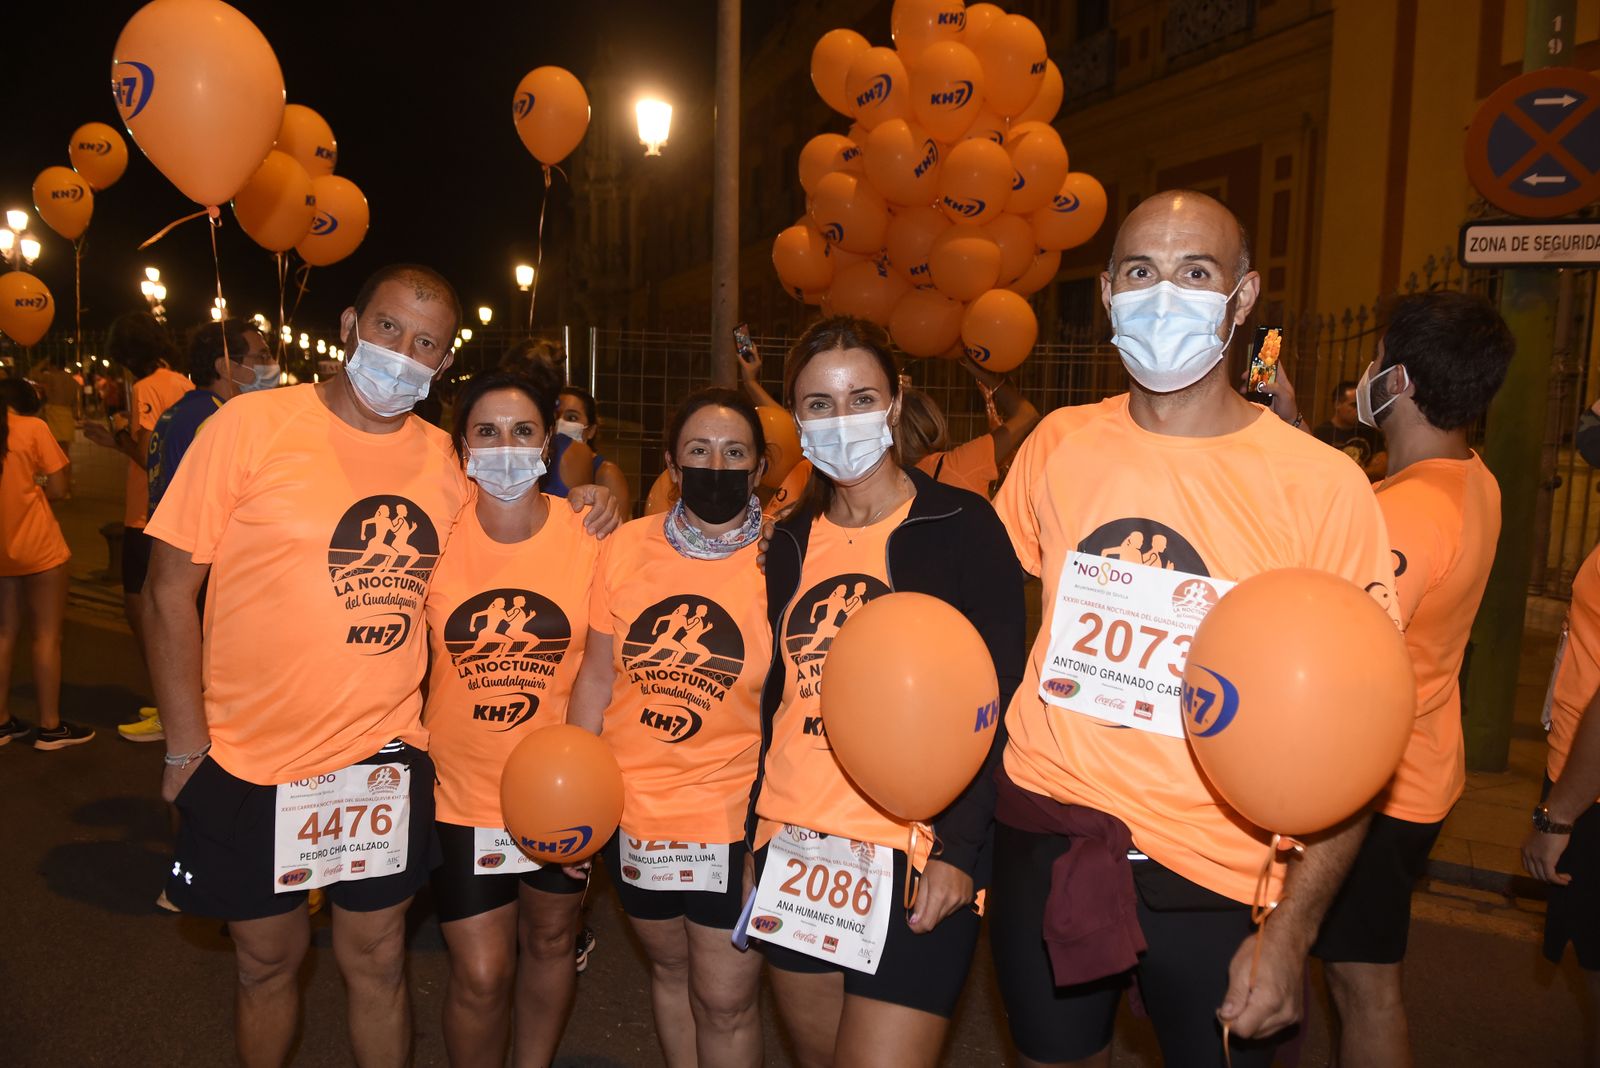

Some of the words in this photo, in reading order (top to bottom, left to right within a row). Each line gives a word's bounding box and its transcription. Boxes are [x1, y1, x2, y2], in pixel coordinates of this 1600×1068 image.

[1470, 236, 1507, 252] ZONA
[1511, 236, 1530, 251] DE
[334, 581, 355, 597] LA
[358, 576, 426, 598] NOCTURNA
[345, 594, 361, 610] del
[1080, 599, 1106, 610] CARRERA
[1106, 606, 1140, 618] NOCTURNA
[1140, 613, 1153, 621] DEL
[1153, 616, 1199, 631] GUADALQUIVI
[1072, 611, 1195, 678] 2073
[458, 666, 473, 680] LA
[475, 660, 557, 678] NOCTURNA
[1053, 655, 1098, 676] ANTONIO
[1100, 668, 1154, 691] GRANADO
[468, 678, 481, 691] del
[481, 675, 547, 690] Guadalquivir
[645, 670, 726, 702] NOCTURNA
[799, 684, 814, 699] del
[651, 683, 712, 711] Guadalquivir
[297, 803, 393, 846] 4476
[300, 849, 328, 860] PEDRO
[329, 844, 347, 856] CHIA
[349, 841, 390, 852] CALZADO
[628, 852, 674, 864] INMACULADA
[675, 854, 693, 863] RUIZ
[694, 853, 716, 862] LUNA
[779, 857, 873, 916] 2086
[776, 900, 794, 913] ANA
[795, 907, 835, 925] HUMANES
[836, 917, 866, 935] MUÑOZ
